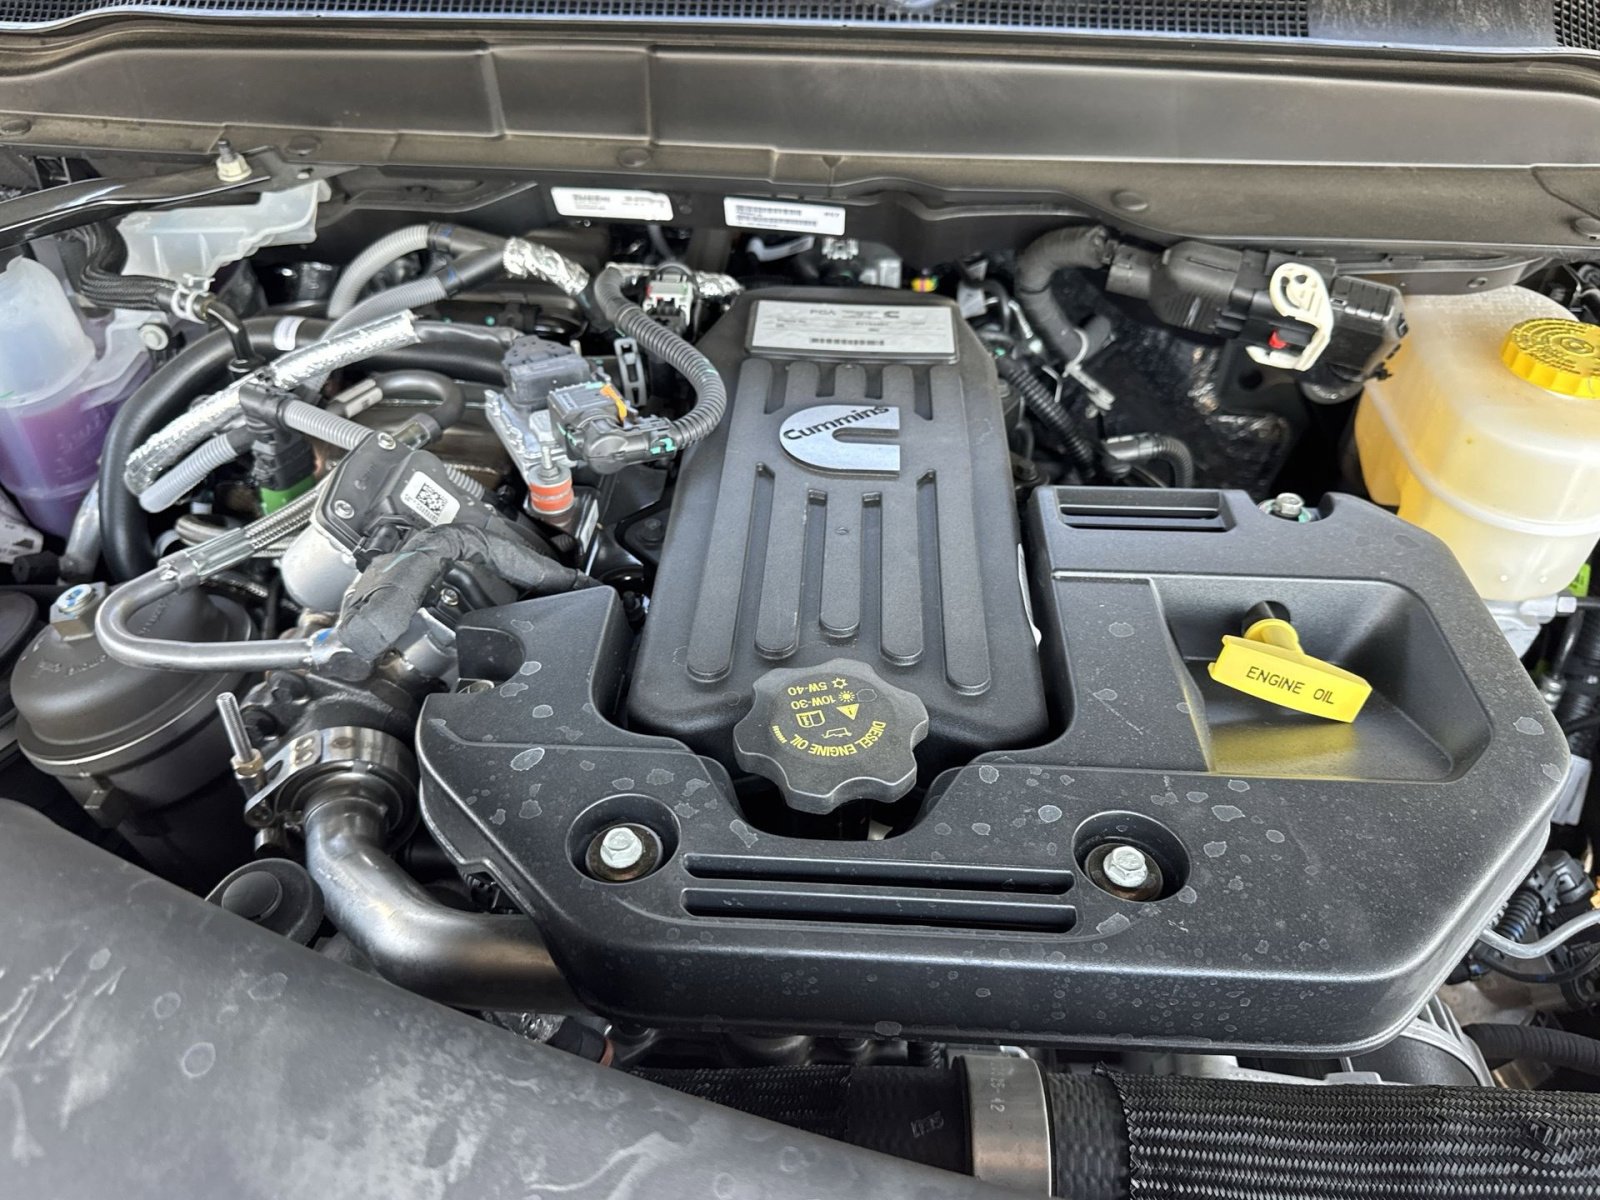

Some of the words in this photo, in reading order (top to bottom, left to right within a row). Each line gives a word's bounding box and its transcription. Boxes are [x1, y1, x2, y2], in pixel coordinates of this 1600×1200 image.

[783, 406, 889, 440] Cummins
[787, 681, 828, 696] 5W-40
[1246, 666, 1305, 694] ENGINE
[1313, 688, 1335, 705] OIL
[790, 694, 836, 710] 10W-30
[790, 733, 809, 750] OIL
[855, 720, 887, 749] DIESEL
[808, 743, 857, 757] ENGINE
